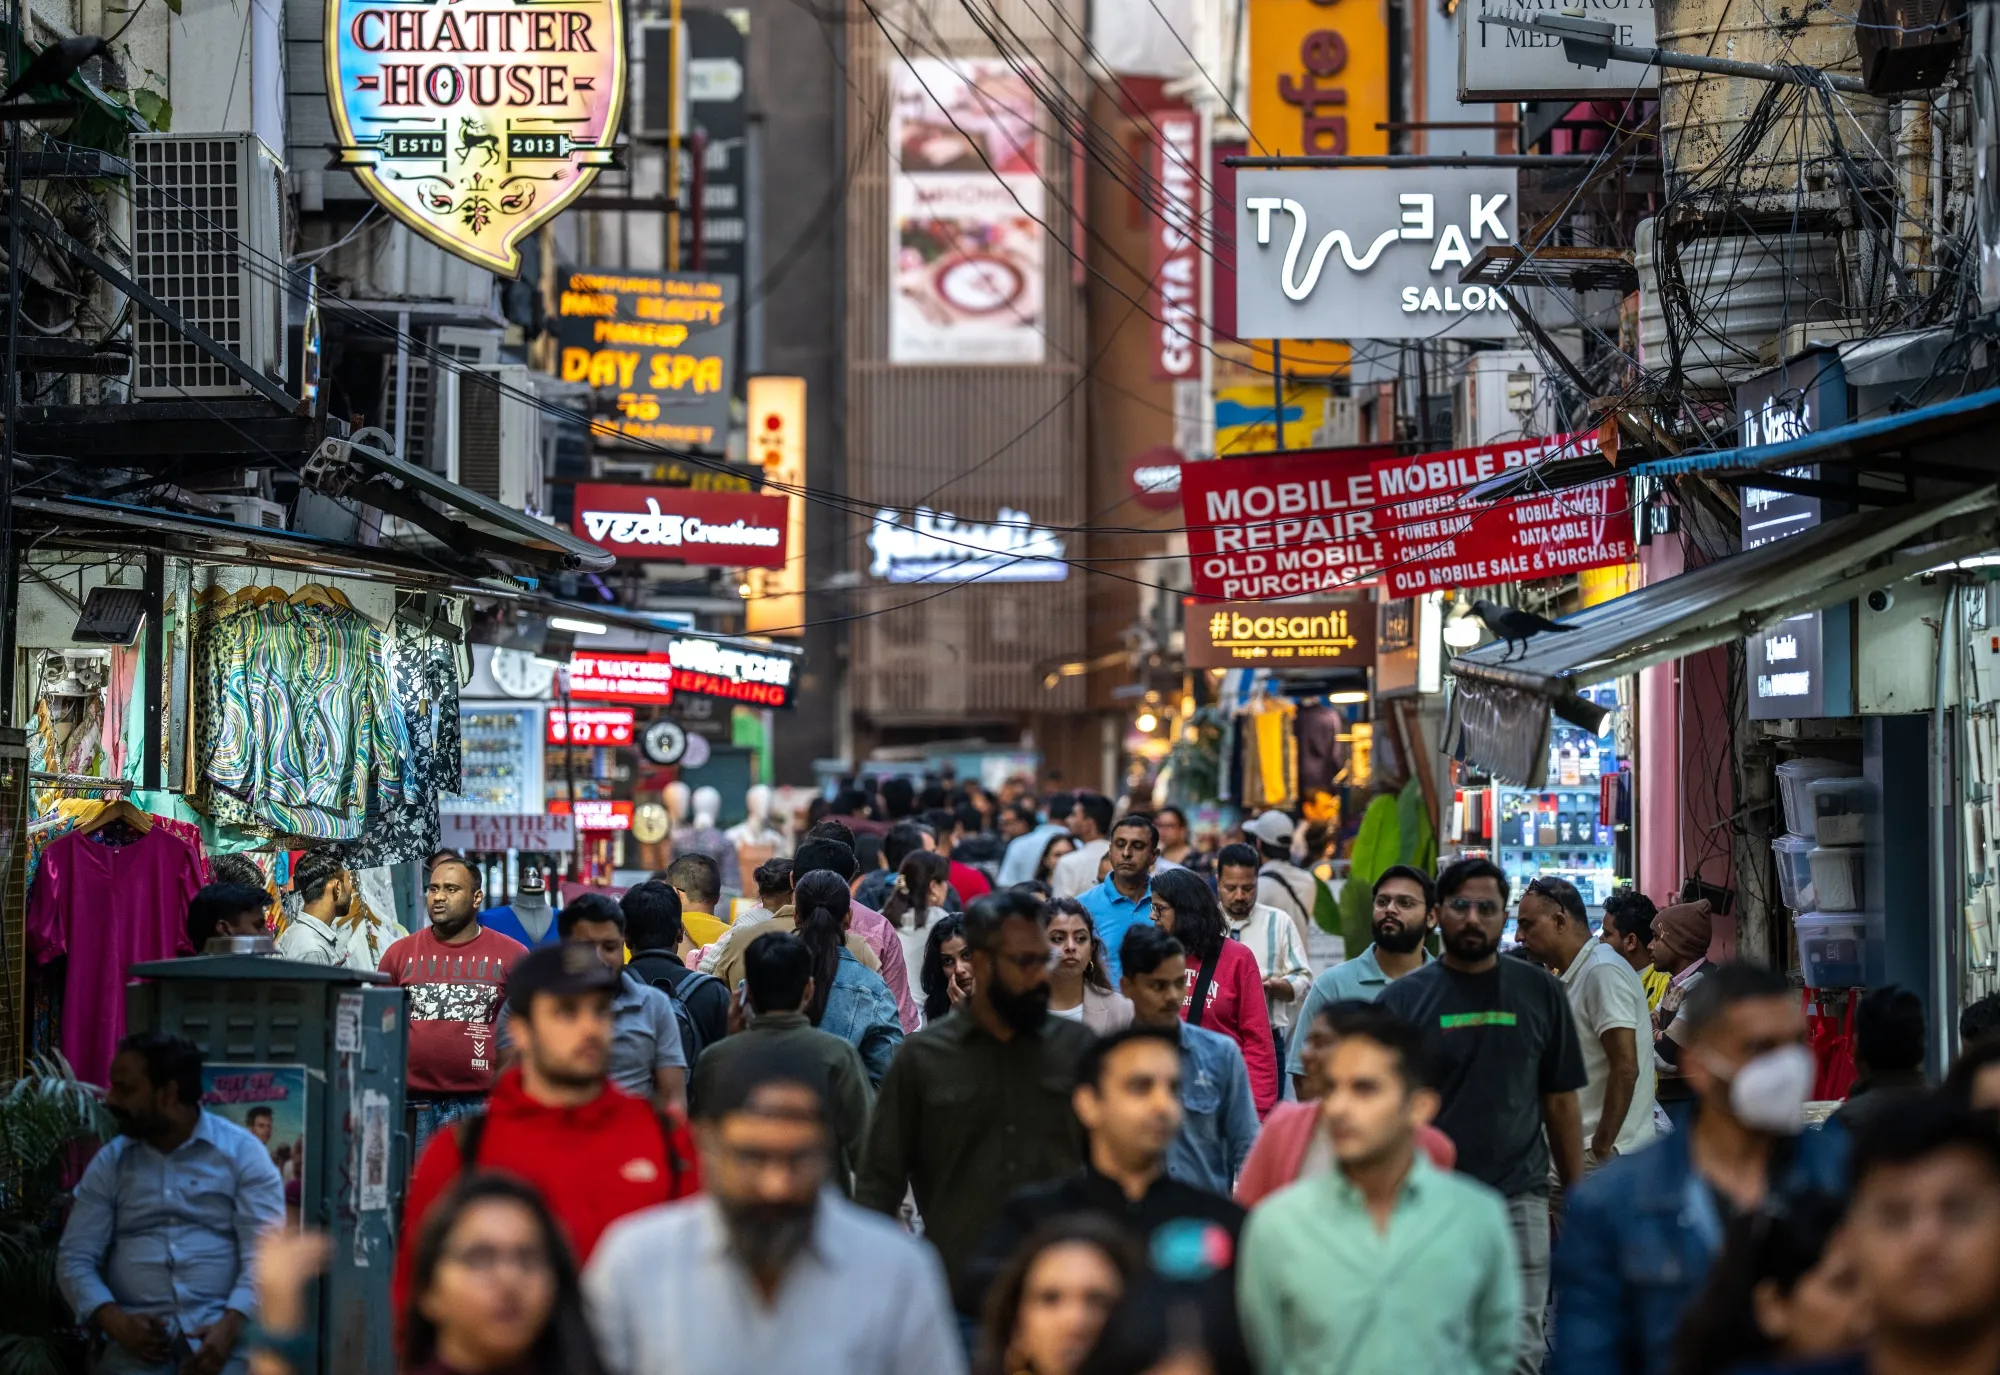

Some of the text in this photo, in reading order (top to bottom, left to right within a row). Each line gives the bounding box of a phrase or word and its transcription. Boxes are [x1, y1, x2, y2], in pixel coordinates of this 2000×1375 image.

[352, 9, 598, 52] CHATTER
[379, 63, 569, 106] HOUSE
[1278, 29, 1348, 157] afe
[398, 138, 443, 152] ESTD
[512, 138, 555, 152] 2013
[1401, 286, 1509, 312] SALON
[562, 347, 723, 393] DAY SPA
[1378, 454, 1494, 498] MOBILE
[1205, 475, 1376, 522] MOBILE
[1516, 496, 1602, 525] MOBILE COVER
[1214, 511, 1377, 555] REPAIR
[1397, 515, 1474, 542] POWER BANK
[1519, 520, 1589, 547] DATA CABLE
[1203, 542, 1384, 579] OLD MOBILE
[1395, 541, 1627, 591] OLD MOBILE SALE & PURCHASE
[1400, 541, 1458, 562] CHARGER
[1223, 564, 1378, 600] PURCHASE
[1209, 609, 1348, 640] #basanti
[454, 814, 567, 832] LEATHER
[474, 834, 549, 850] BELTS
